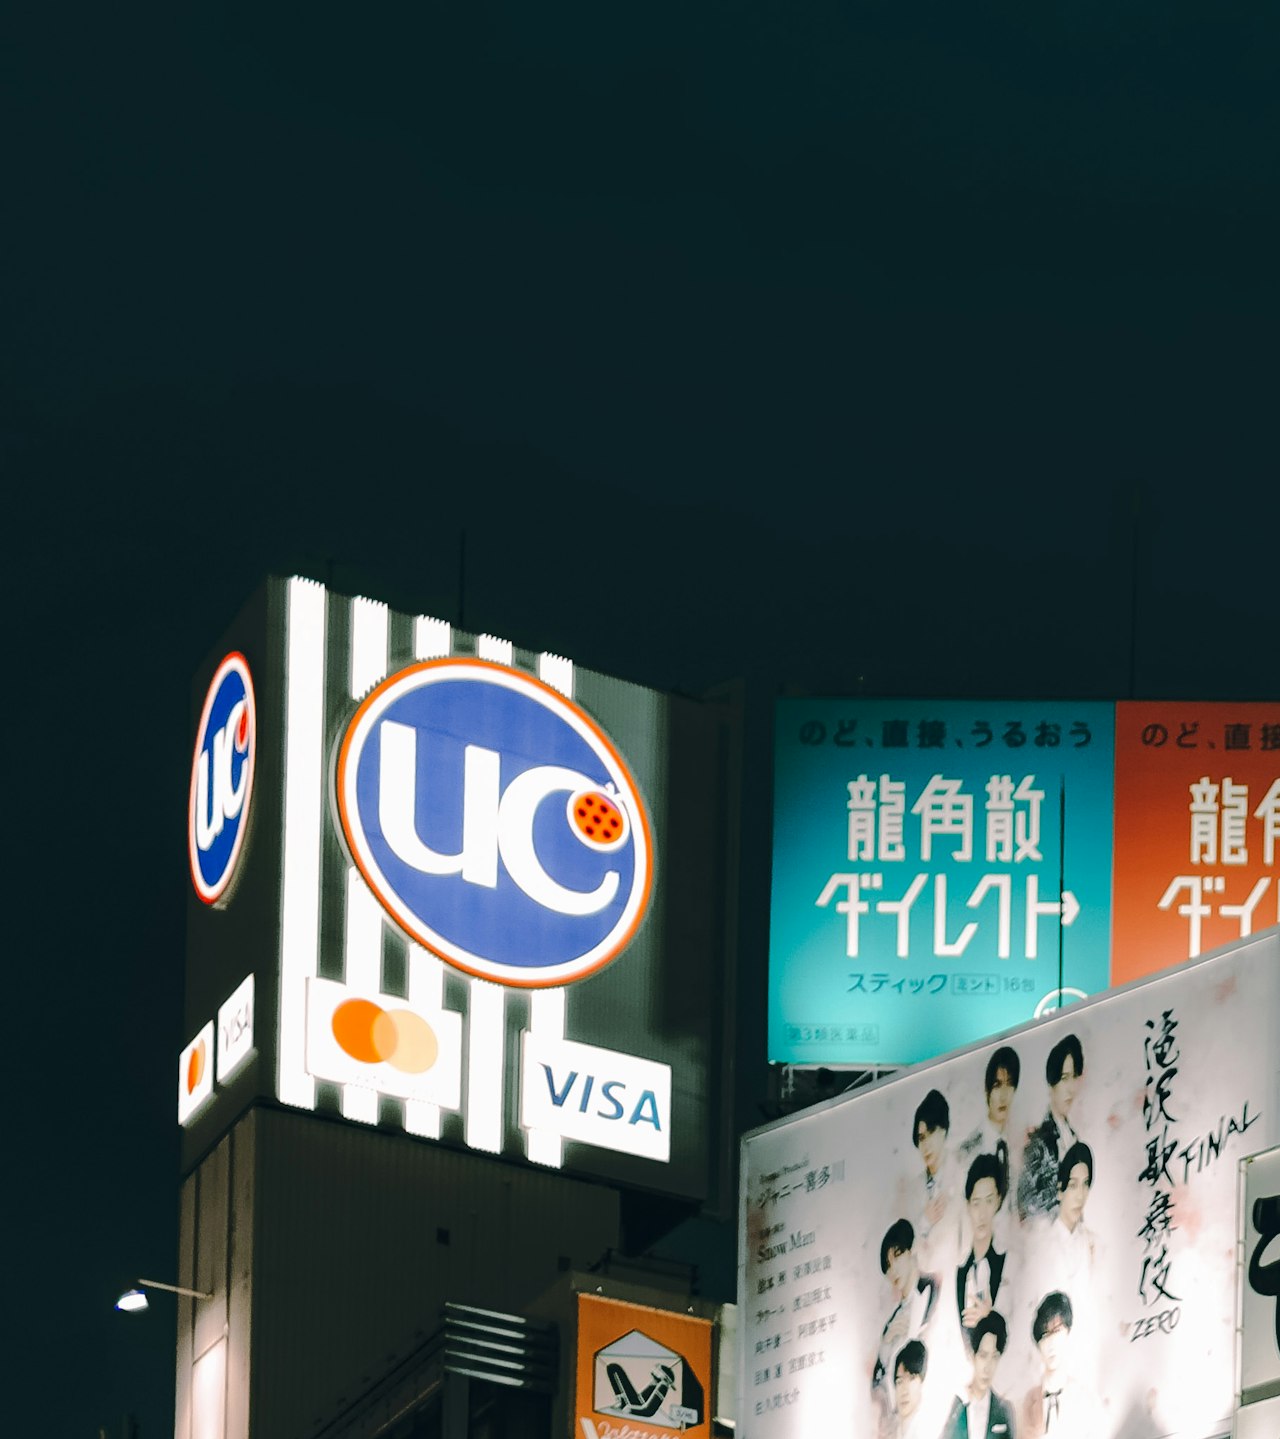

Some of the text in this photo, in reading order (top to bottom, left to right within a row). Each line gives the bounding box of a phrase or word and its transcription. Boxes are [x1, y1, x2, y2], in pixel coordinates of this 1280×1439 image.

[800, 718, 1093, 751] のど、直接、うるおう
[846, 774, 1045, 863] 龍角散
[815, 872, 1081, 958] ダイレクト
[846, 973, 948, 995] スティック
[537, 1061, 662, 1132] VISA
[1178, 1100, 1263, 1185] FINAL
[1130, 1306, 1181, 1343] ZERO
